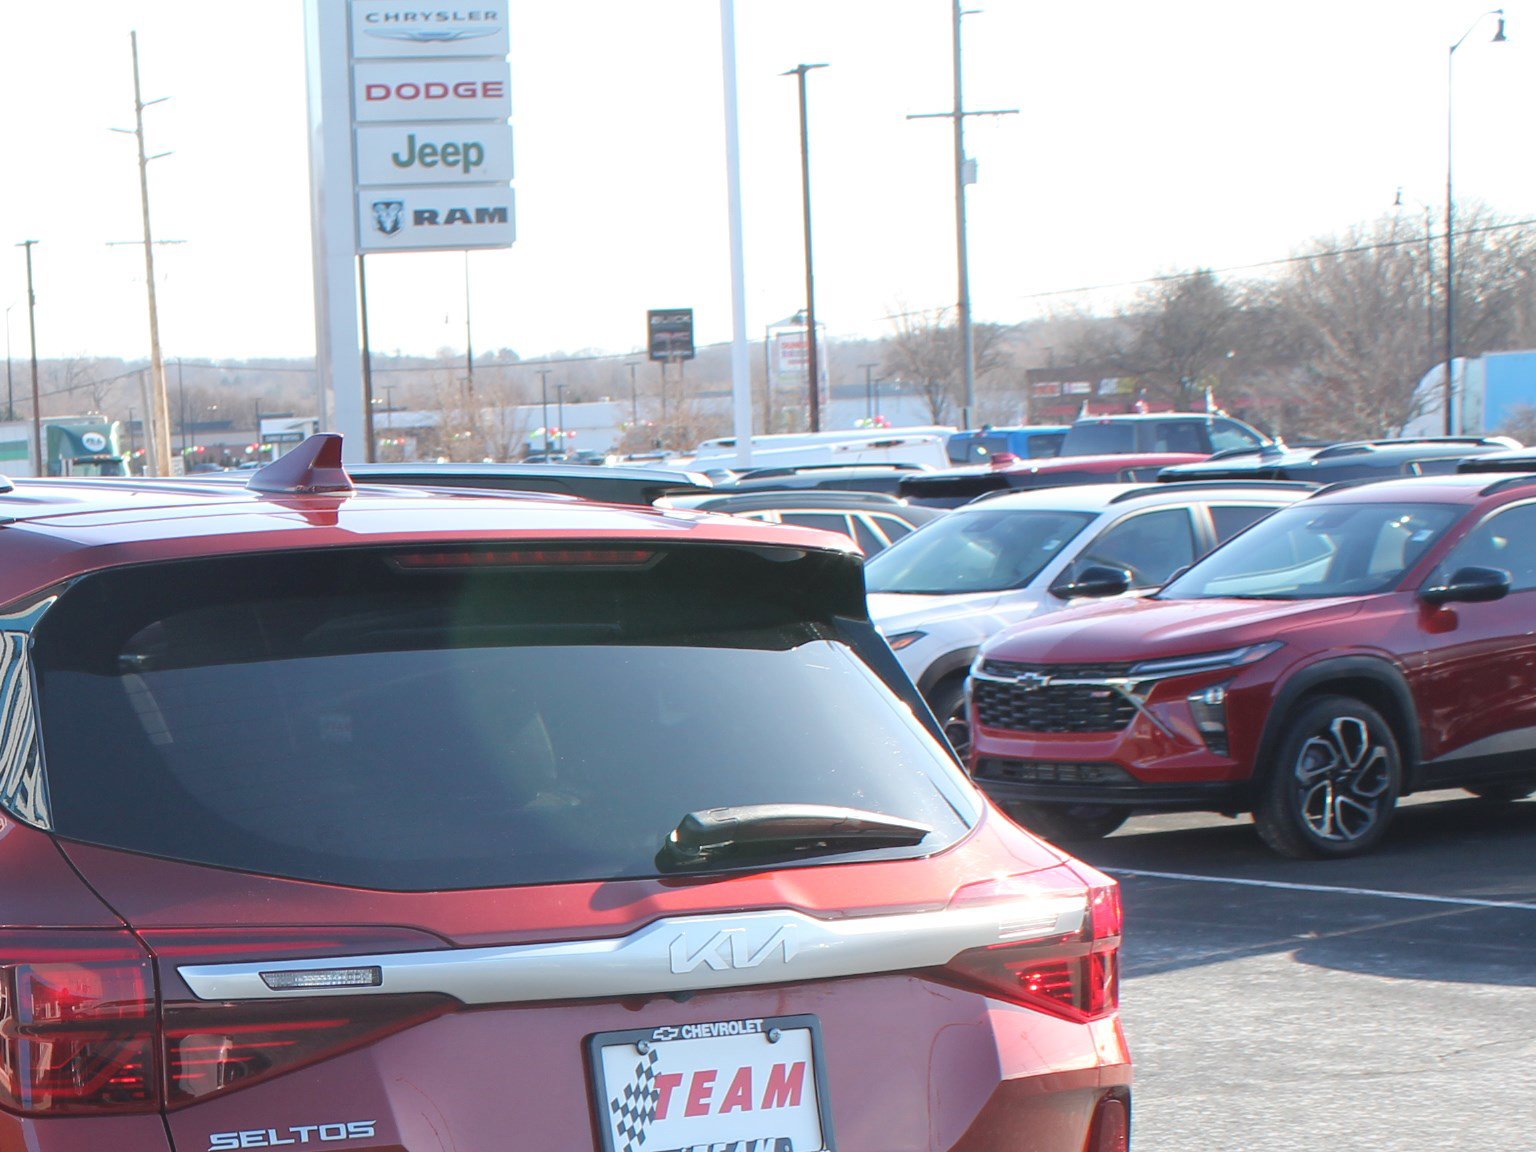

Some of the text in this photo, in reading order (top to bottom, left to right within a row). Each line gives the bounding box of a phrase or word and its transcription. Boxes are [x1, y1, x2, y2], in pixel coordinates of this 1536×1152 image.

[365, 10, 499, 24] CHRYSLER
[365, 80, 506, 102] DODGE
[391, 133, 485, 175] Jeep
[412, 205, 509, 227] RAM
[669, 923, 800, 974] KIA
[680, 1018, 764, 1040] CHEVROLET
[653, 1061, 806, 1121] TEAM
[207, 1119, 377, 1152] SELTOS
